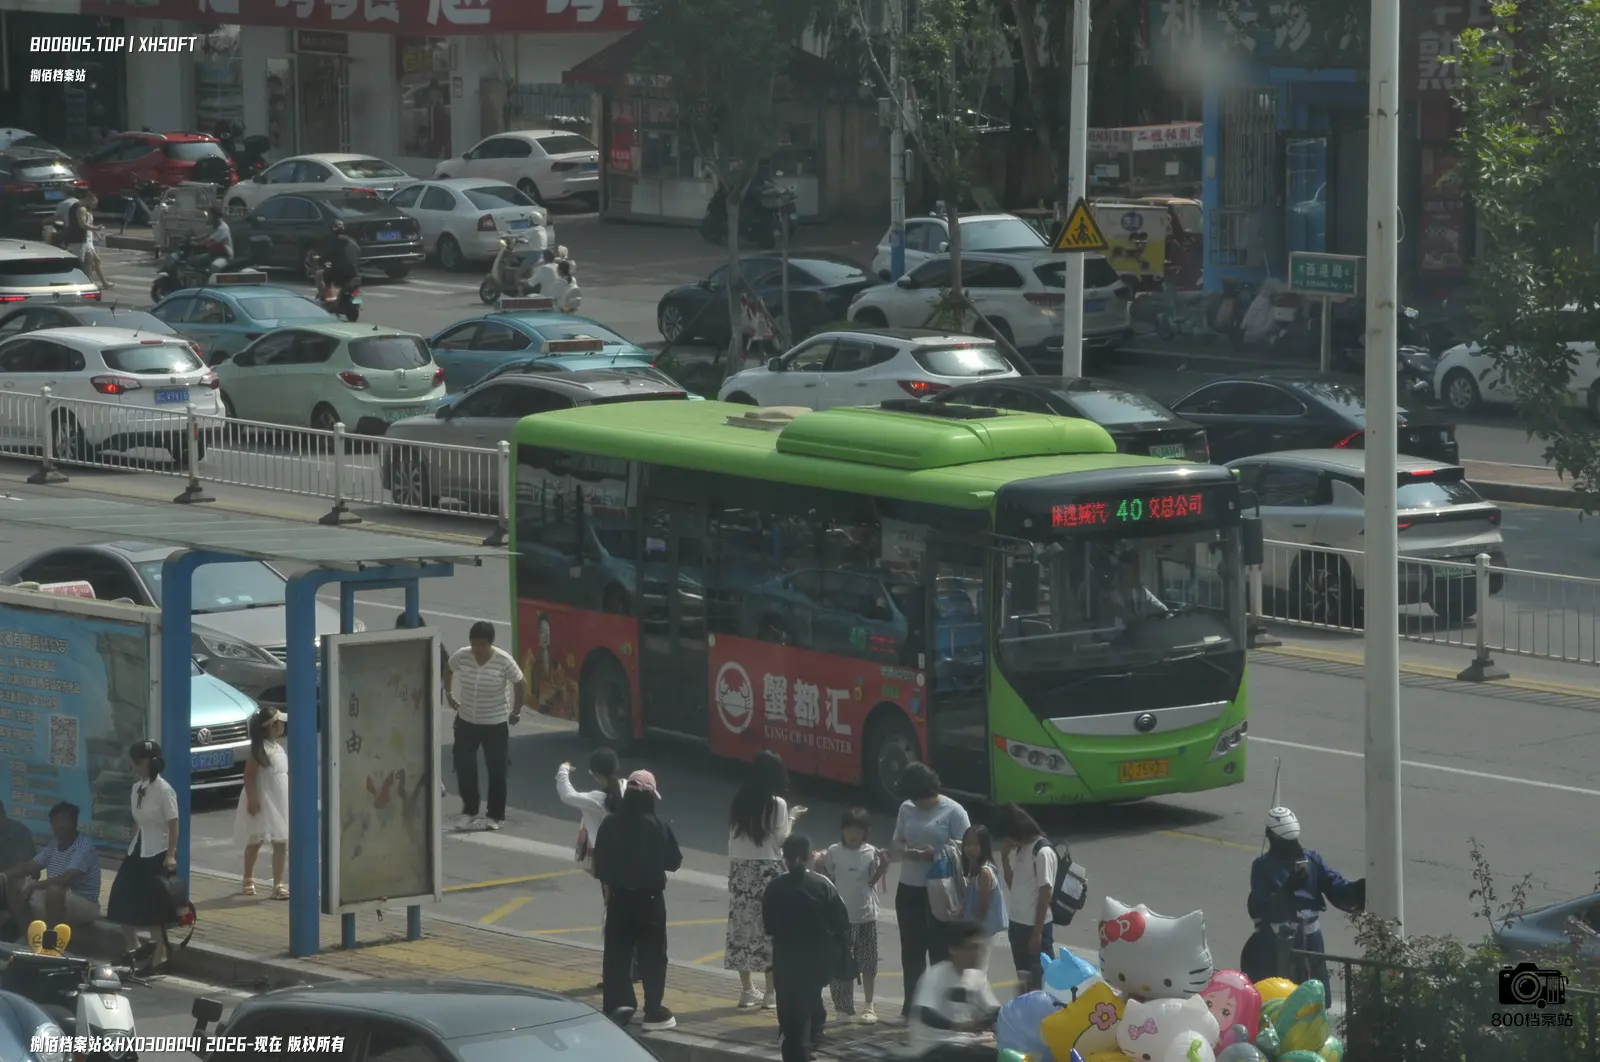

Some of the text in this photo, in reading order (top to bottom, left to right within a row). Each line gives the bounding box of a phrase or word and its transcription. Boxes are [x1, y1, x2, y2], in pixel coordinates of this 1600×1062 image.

[1116, 498, 1143, 522] 40
[1149, 493, 1203, 519] 交总公司
[345, 691, 363, 755] 自由
[762, 672, 852, 735] 蟹都汇
[764, 724, 788, 742] KING
[816, 734, 852, 755] CENTER
